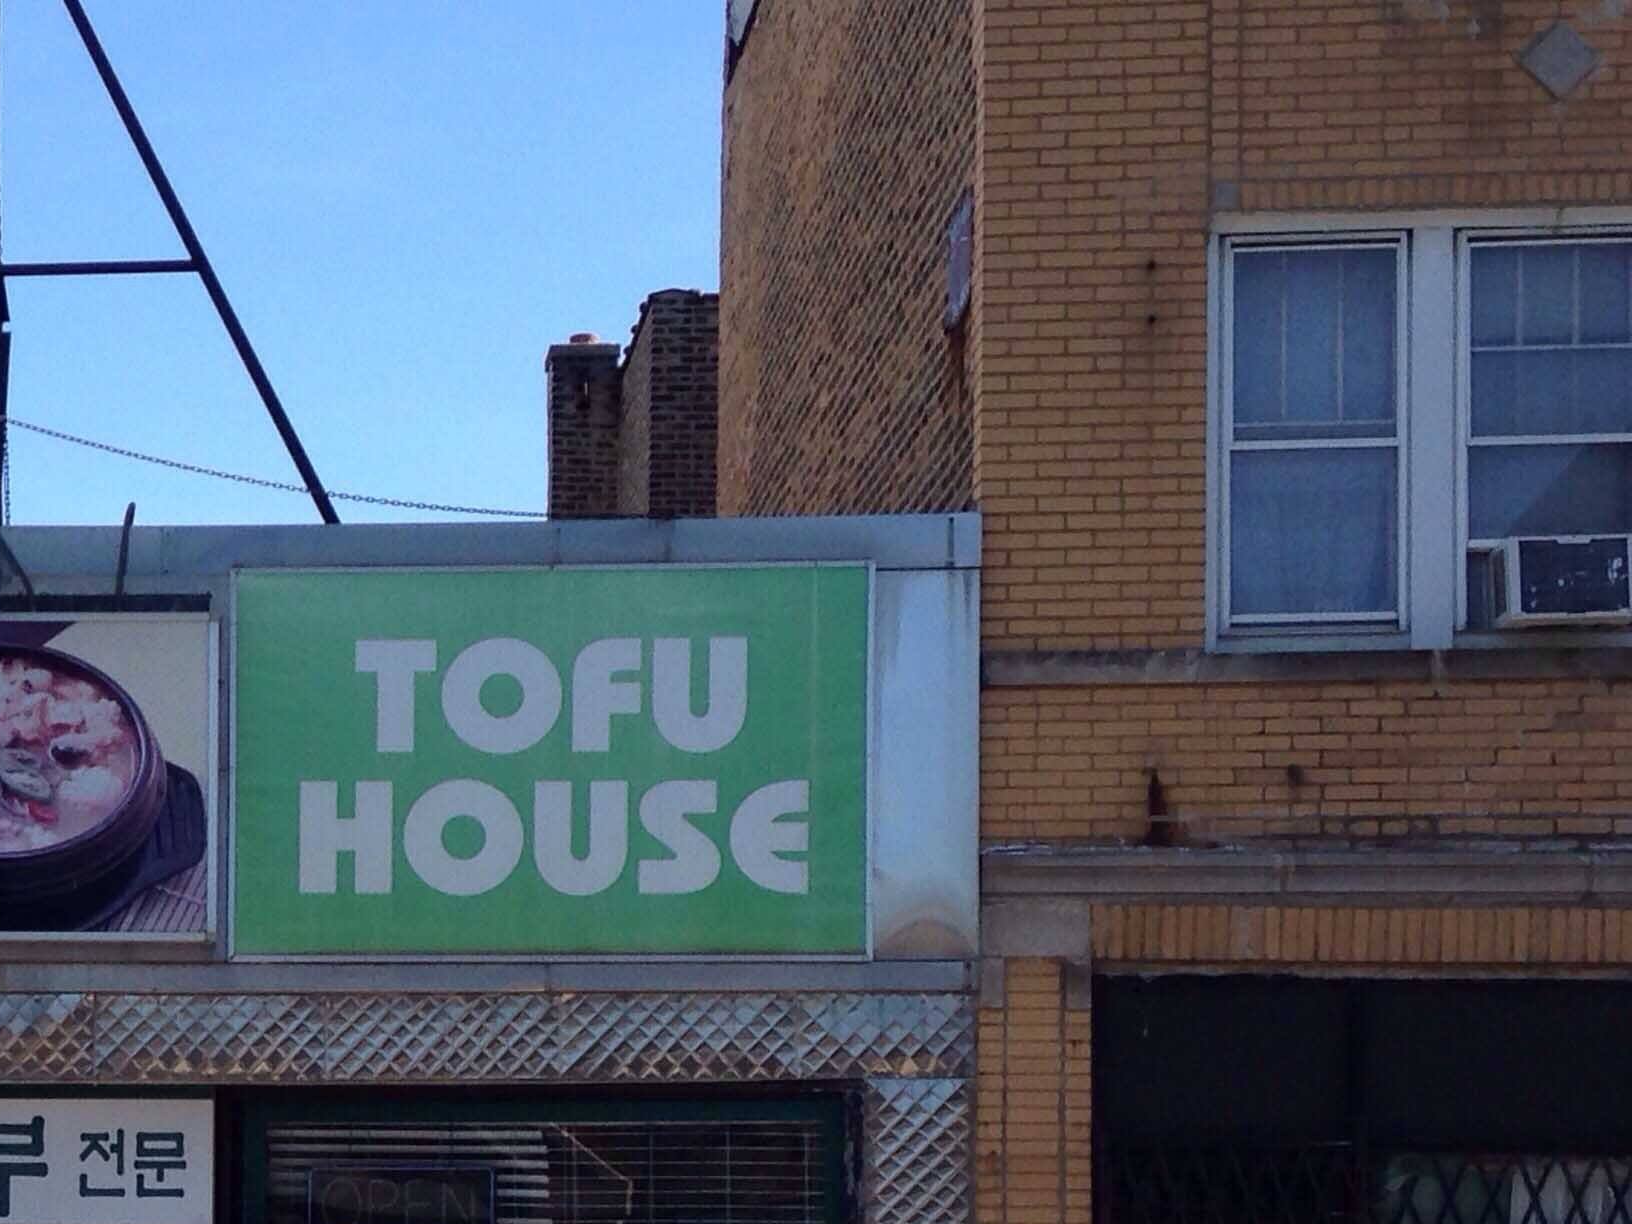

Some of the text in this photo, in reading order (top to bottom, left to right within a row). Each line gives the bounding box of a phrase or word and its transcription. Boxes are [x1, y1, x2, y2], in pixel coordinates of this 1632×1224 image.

[354, 635, 749, 754] TOFU
[298, 778, 810, 896] HOUSE
[79, 1128, 187, 1198] 전문
